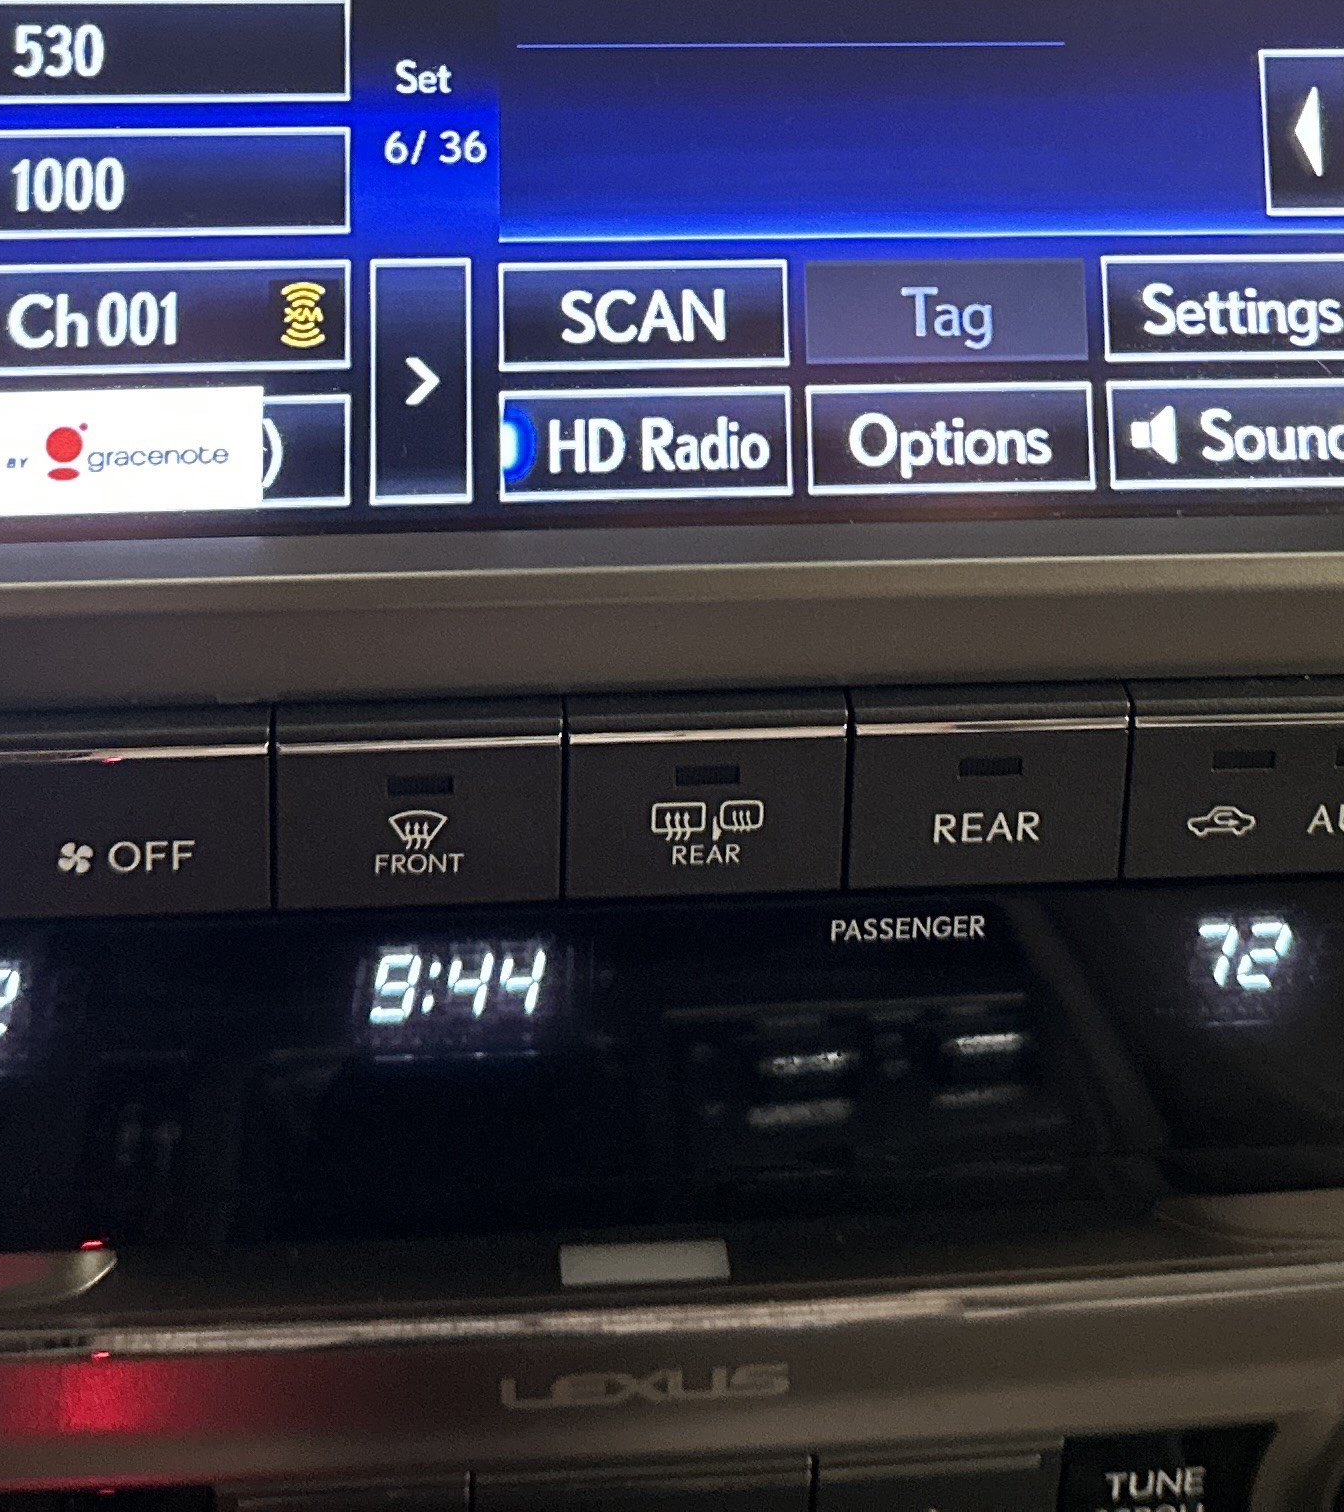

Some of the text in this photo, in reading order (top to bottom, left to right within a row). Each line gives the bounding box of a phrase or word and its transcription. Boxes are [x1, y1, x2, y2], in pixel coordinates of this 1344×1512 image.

[12, 22, 106, 79] 530
[394, 59, 454, 94] Set
[10, 156, 126, 213] 1000
[559, 287, 728, 345] SCAN
[899, 286, 994, 351] Tag
[5, 457, 29, 470] BY
[86, 445, 230, 473] gracenote
[547, 415, 771, 474] HD Radio
[847, 410, 1054, 480] Options
[932, 810, 1042, 844] REAR
[107, 839, 196, 873] OFF
[373, 852, 466, 875] FRONT
[670, 842, 742, 866] REAR
[829, 914, 986, 943] PASSENGER
[1197, 920, 1294, 992] 72
[369, 948, 546, 1024] 9:44
[499, 1362, 790, 1410] LEXUS
[1104, 1465, 1206, 1501] TUNE
